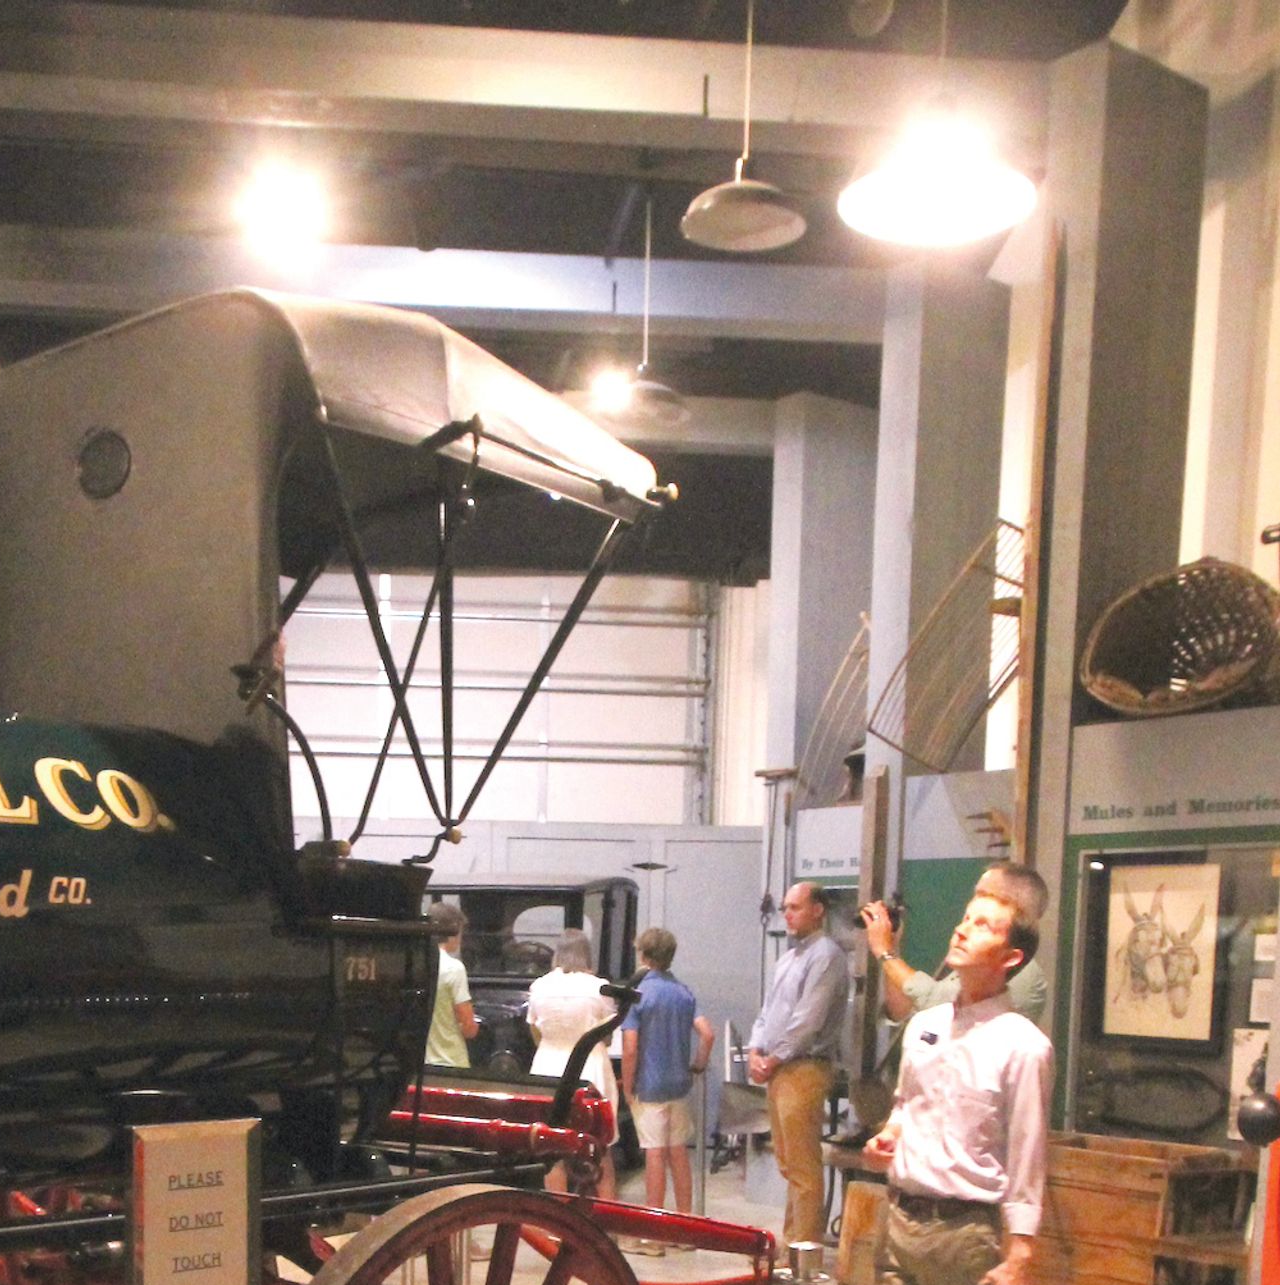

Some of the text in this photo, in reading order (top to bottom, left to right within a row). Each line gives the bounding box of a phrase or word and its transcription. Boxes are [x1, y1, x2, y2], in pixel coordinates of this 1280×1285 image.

[1082, 804, 1134, 820] Mules
[1144, 802, 1177, 817] and
[48, 876, 92, 906] CO.
[168, 1170, 224, 1190] PLEASE
[169, 1211, 224, 1232] DO NOT
[171, 1252, 222, 1273] TOUCH
